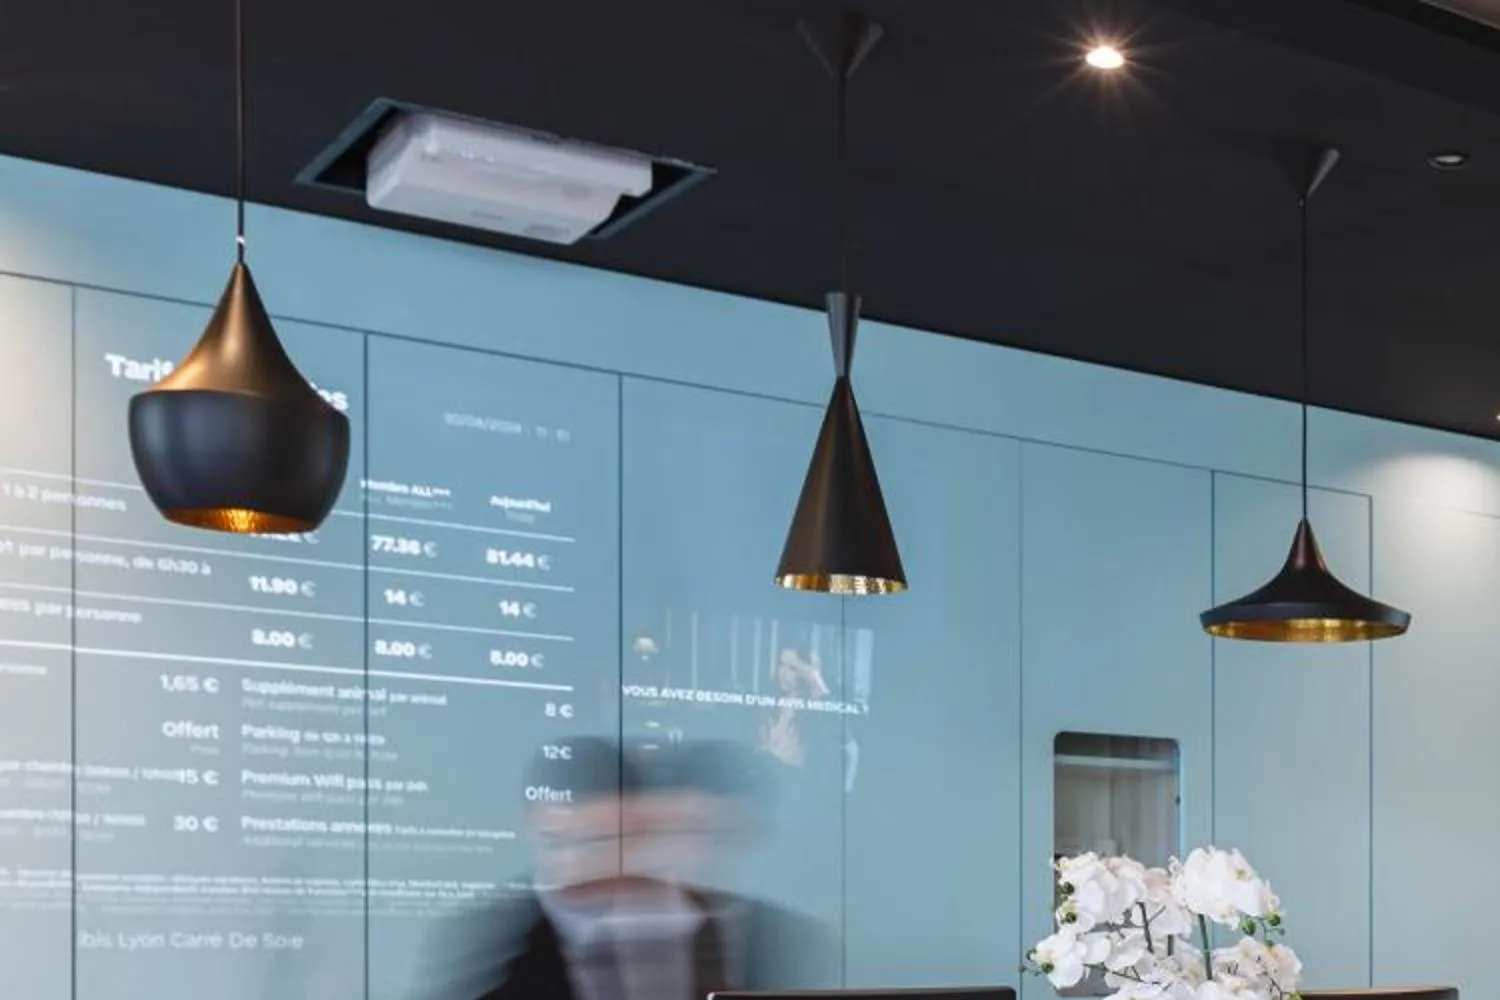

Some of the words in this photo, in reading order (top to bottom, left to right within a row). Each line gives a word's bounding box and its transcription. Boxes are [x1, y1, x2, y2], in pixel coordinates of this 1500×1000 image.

[384, 588, 407, 606] 14
[498, 600, 520, 618] 14
[203, 677, 219, 693] €
[622, 684, 658, 699] VOUS
[559, 703, 574, 719] €
[161, 720, 220, 740] Offert
[202, 769, 219, 786] €
[525, 785, 573, 802] Offert
[173, 815, 199, 832] 30
[202, 816, 219, 832] €
[118, 932, 166, 952] Lyon
[229, 932, 258, 948] De
